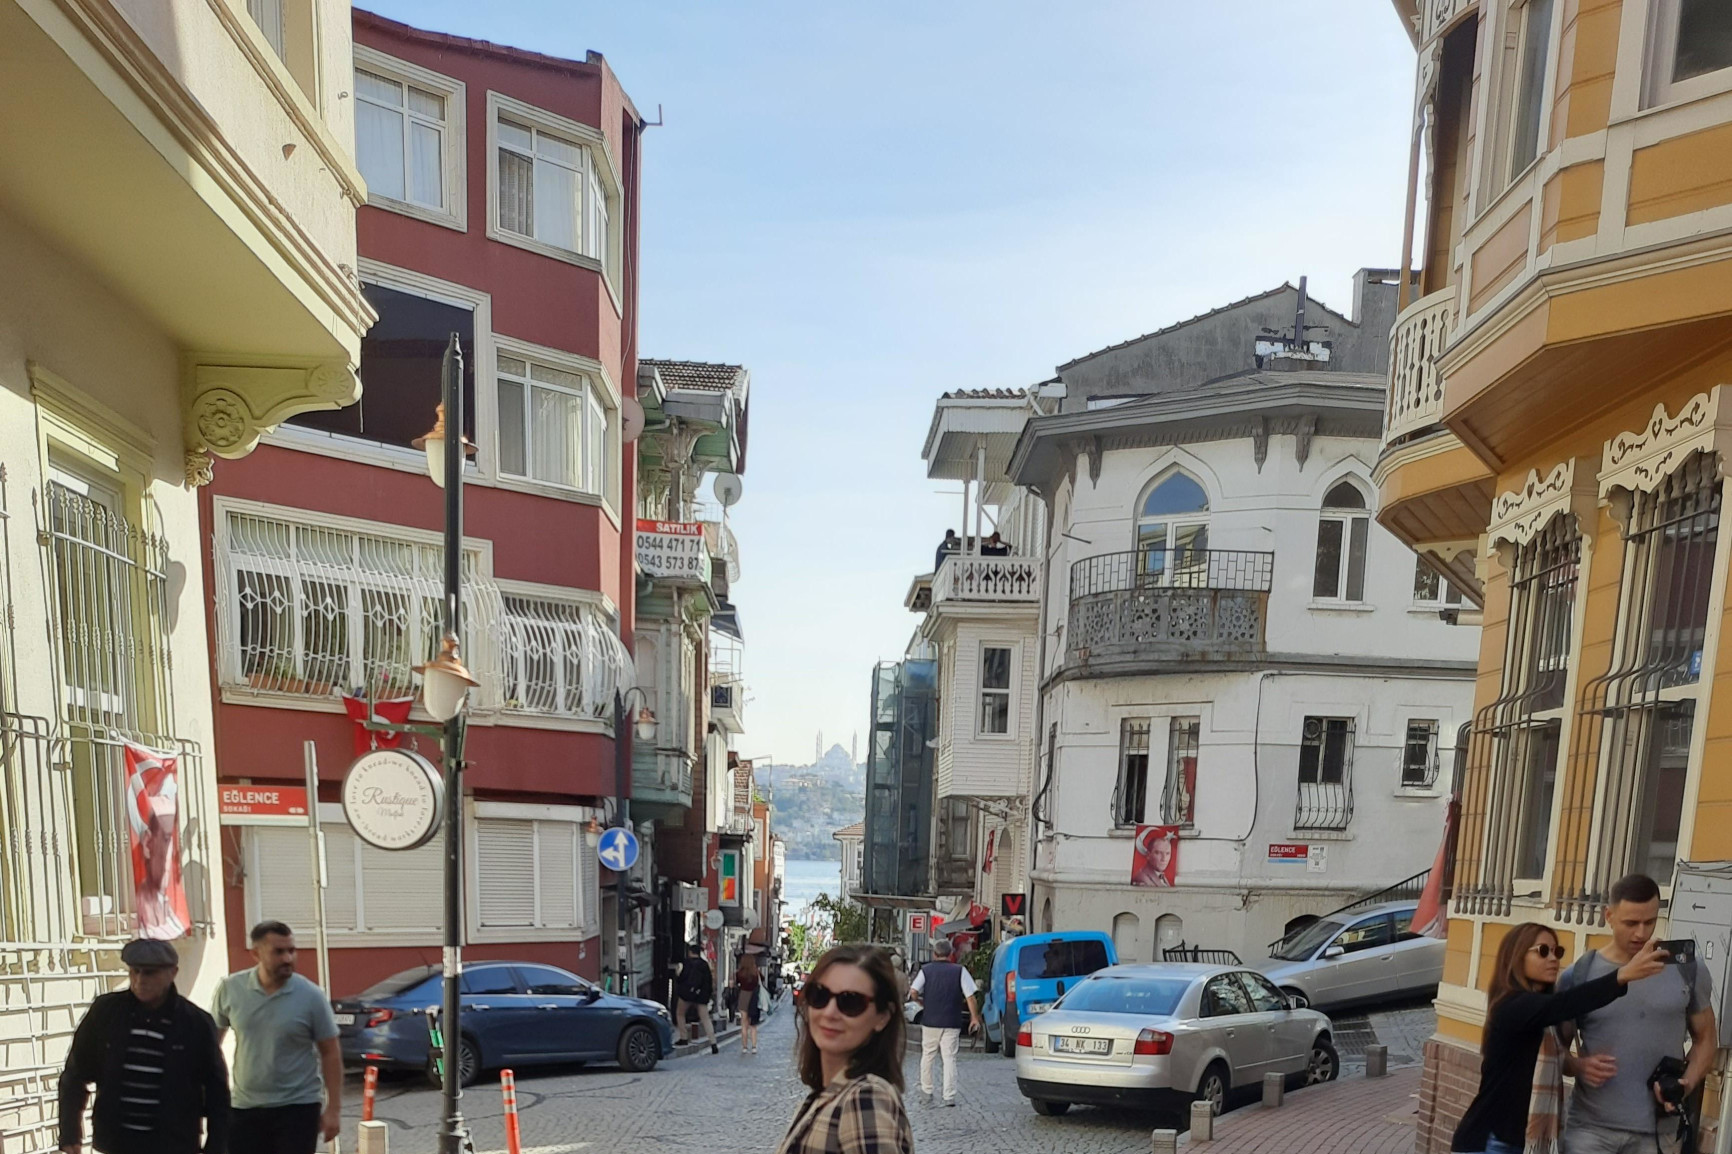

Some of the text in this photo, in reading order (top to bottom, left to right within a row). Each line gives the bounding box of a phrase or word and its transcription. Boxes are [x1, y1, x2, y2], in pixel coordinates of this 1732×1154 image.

[656, 522, 699, 534] SATILIK
[636, 535, 664, 551] 0544
[667, 538, 685, 552] 471
[637, 553, 700, 571] 0543 573 87
[223, 789, 280, 804] EĞLENCE
[361, 786, 419, 810] Rustique
[912, 917, 923, 929] E
[1060, 1038, 1070, 1048] 34
[1093, 1040, 1107, 1051] 133
